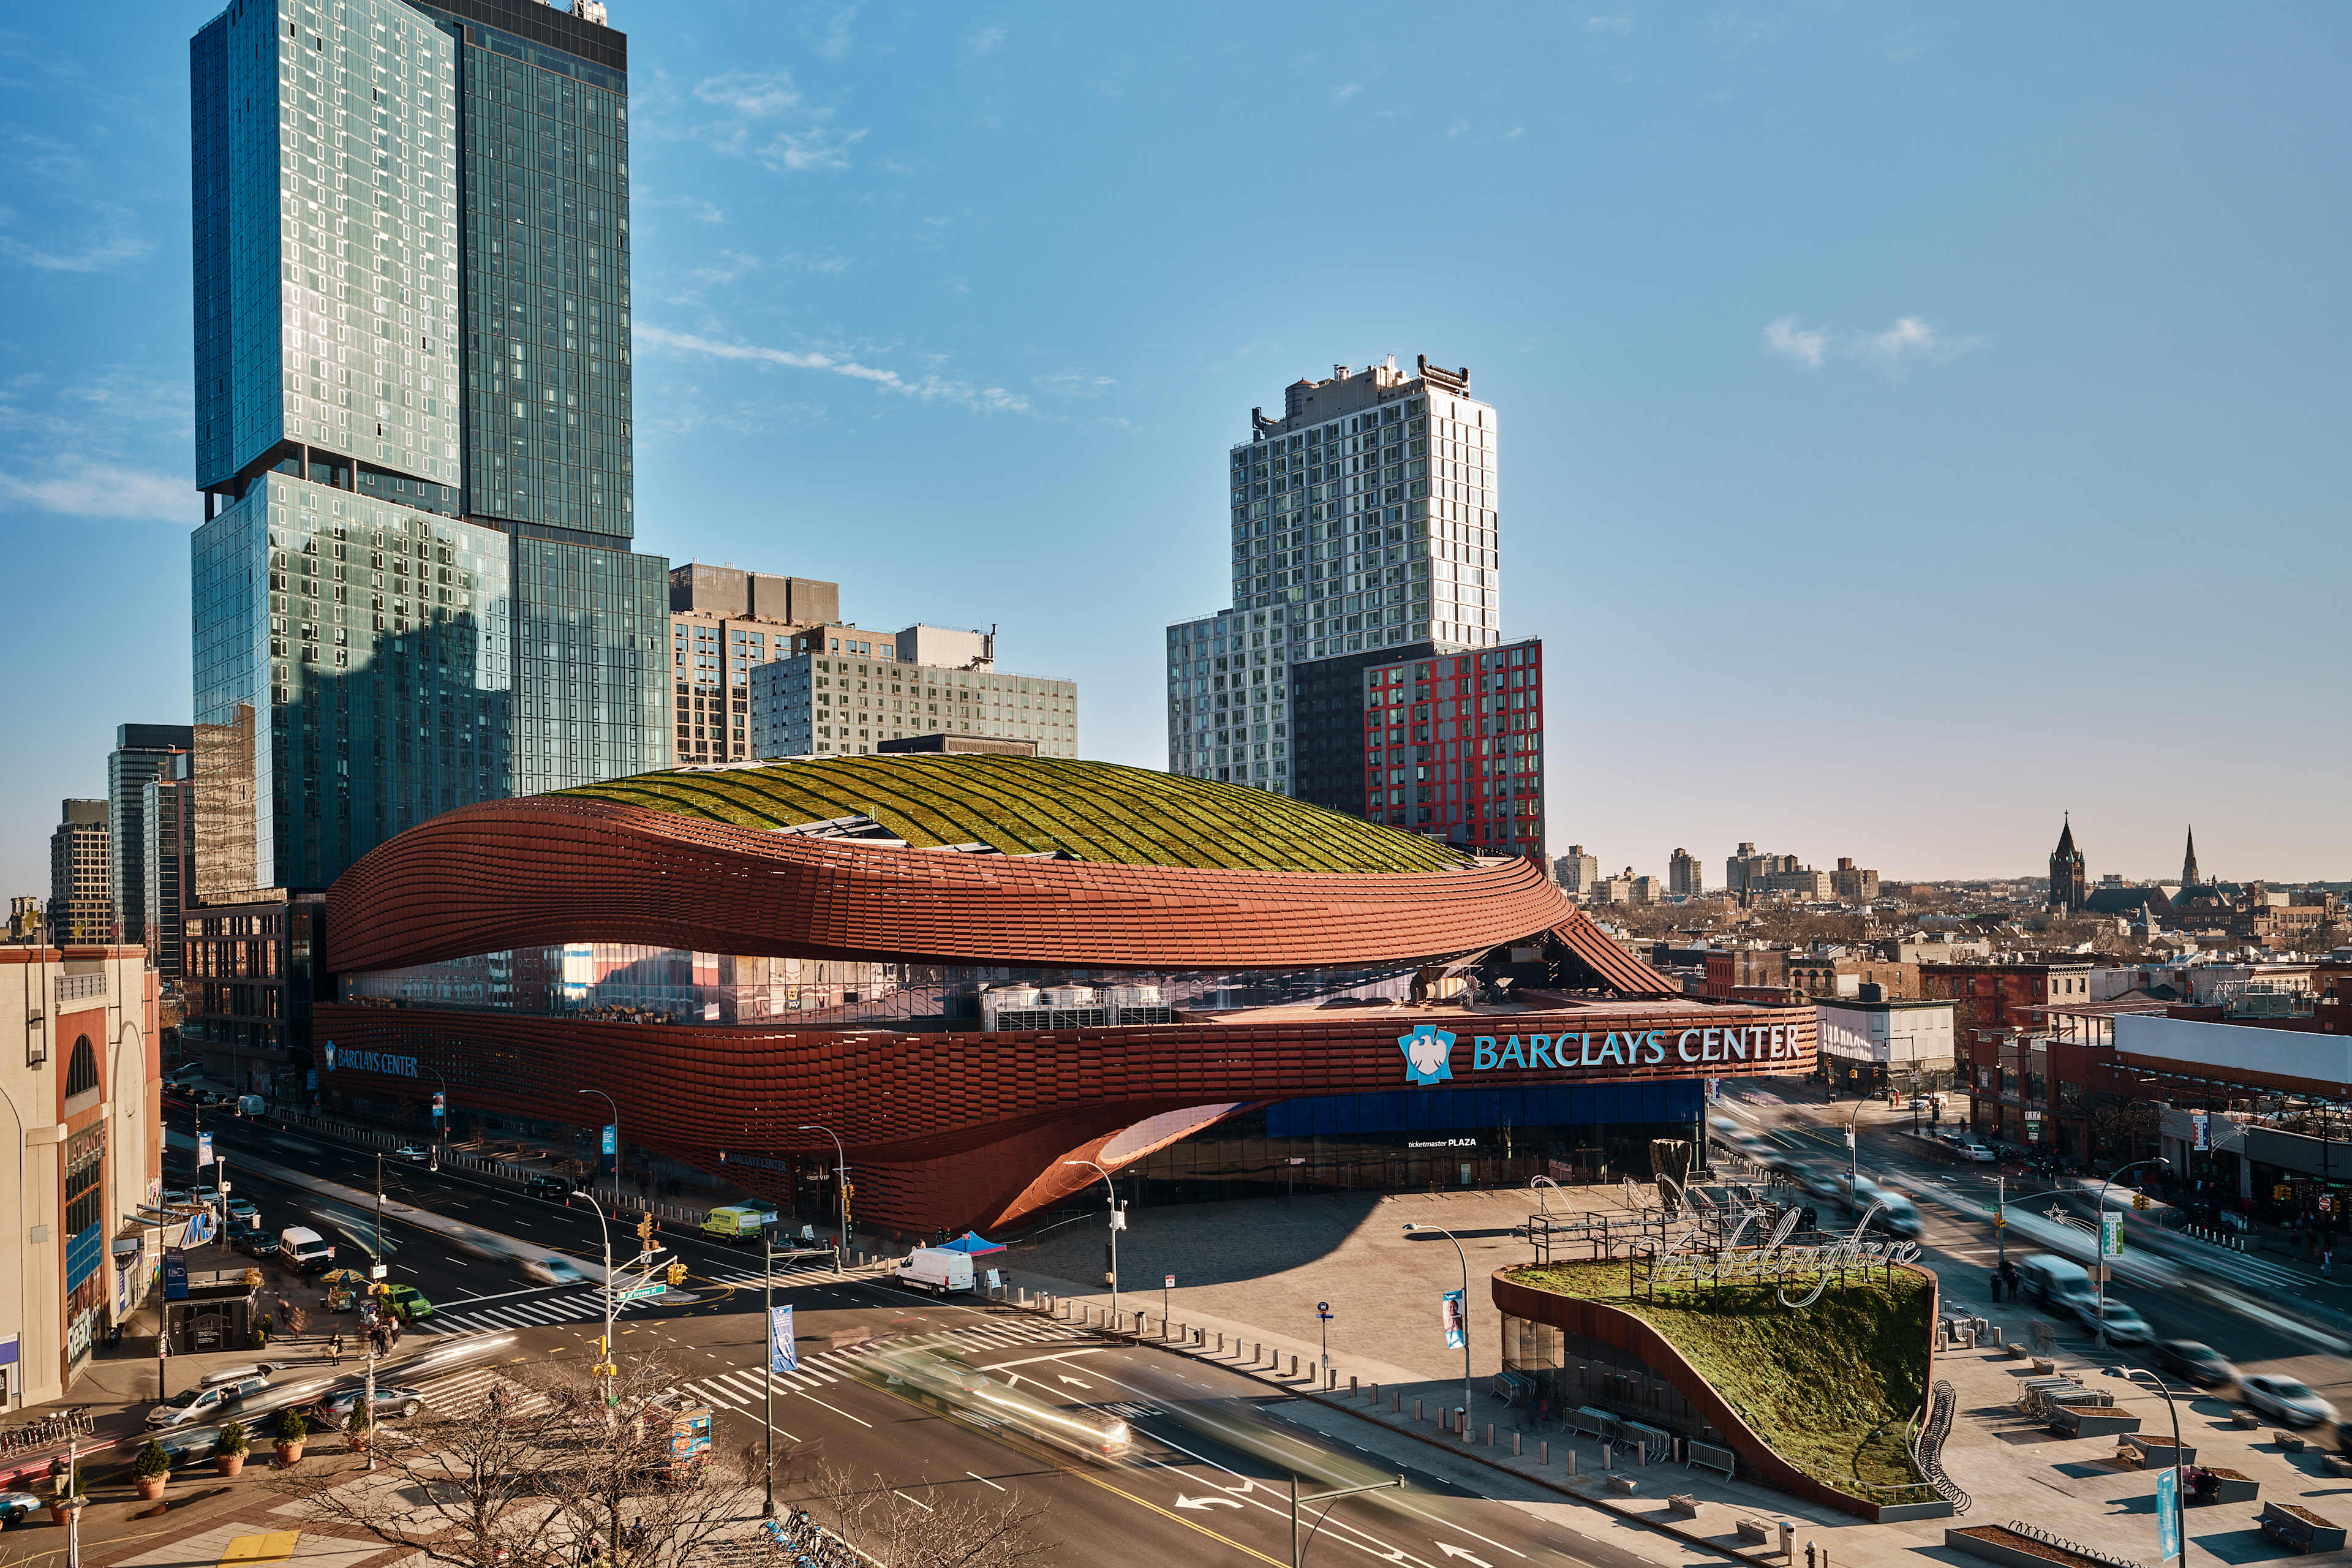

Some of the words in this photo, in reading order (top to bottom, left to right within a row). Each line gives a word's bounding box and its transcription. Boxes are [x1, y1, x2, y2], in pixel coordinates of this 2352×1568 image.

[1473, 1030, 1665, 1070] BARCLAYS
[1678, 1025, 1802, 1062] CENTER
[338, 1048, 379, 1072] BARCLAYS
[382, 1054, 417, 1078] CENTER
[72, 1128, 106, 1163] ATLANTIC
[1448, 1138, 1476, 1147] PLAZA
[729, 1152, 760, 1167] BARCLAYS
[761, 1157, 787, 1172] CENTER
[1715, 1207, 1845, 1308] belong
[1841, 1200, 1921, 1269] here
[1104, 1400, 1170, 1419] ONLY
